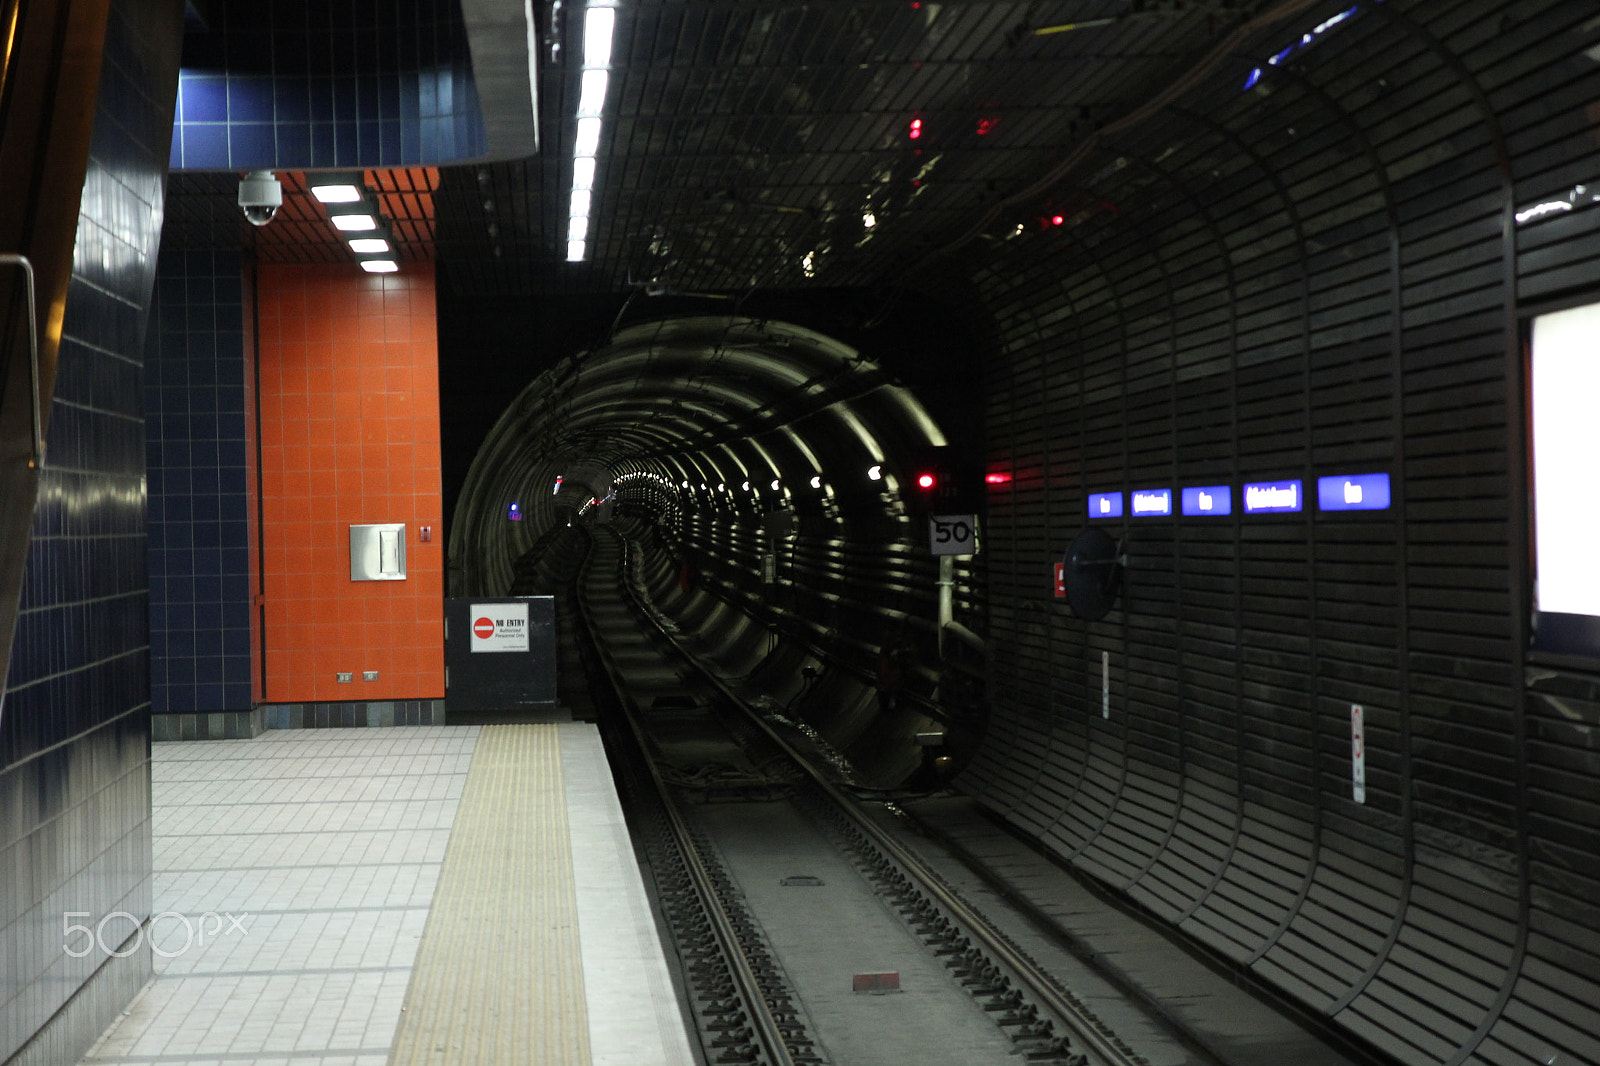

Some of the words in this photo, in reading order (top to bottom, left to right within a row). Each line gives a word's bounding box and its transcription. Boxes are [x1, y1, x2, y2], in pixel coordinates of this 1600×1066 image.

[935, 521, 970, 544] 50
[496, 619, 504, 627] NO
[507, 619, 525, 627] ENTRY
